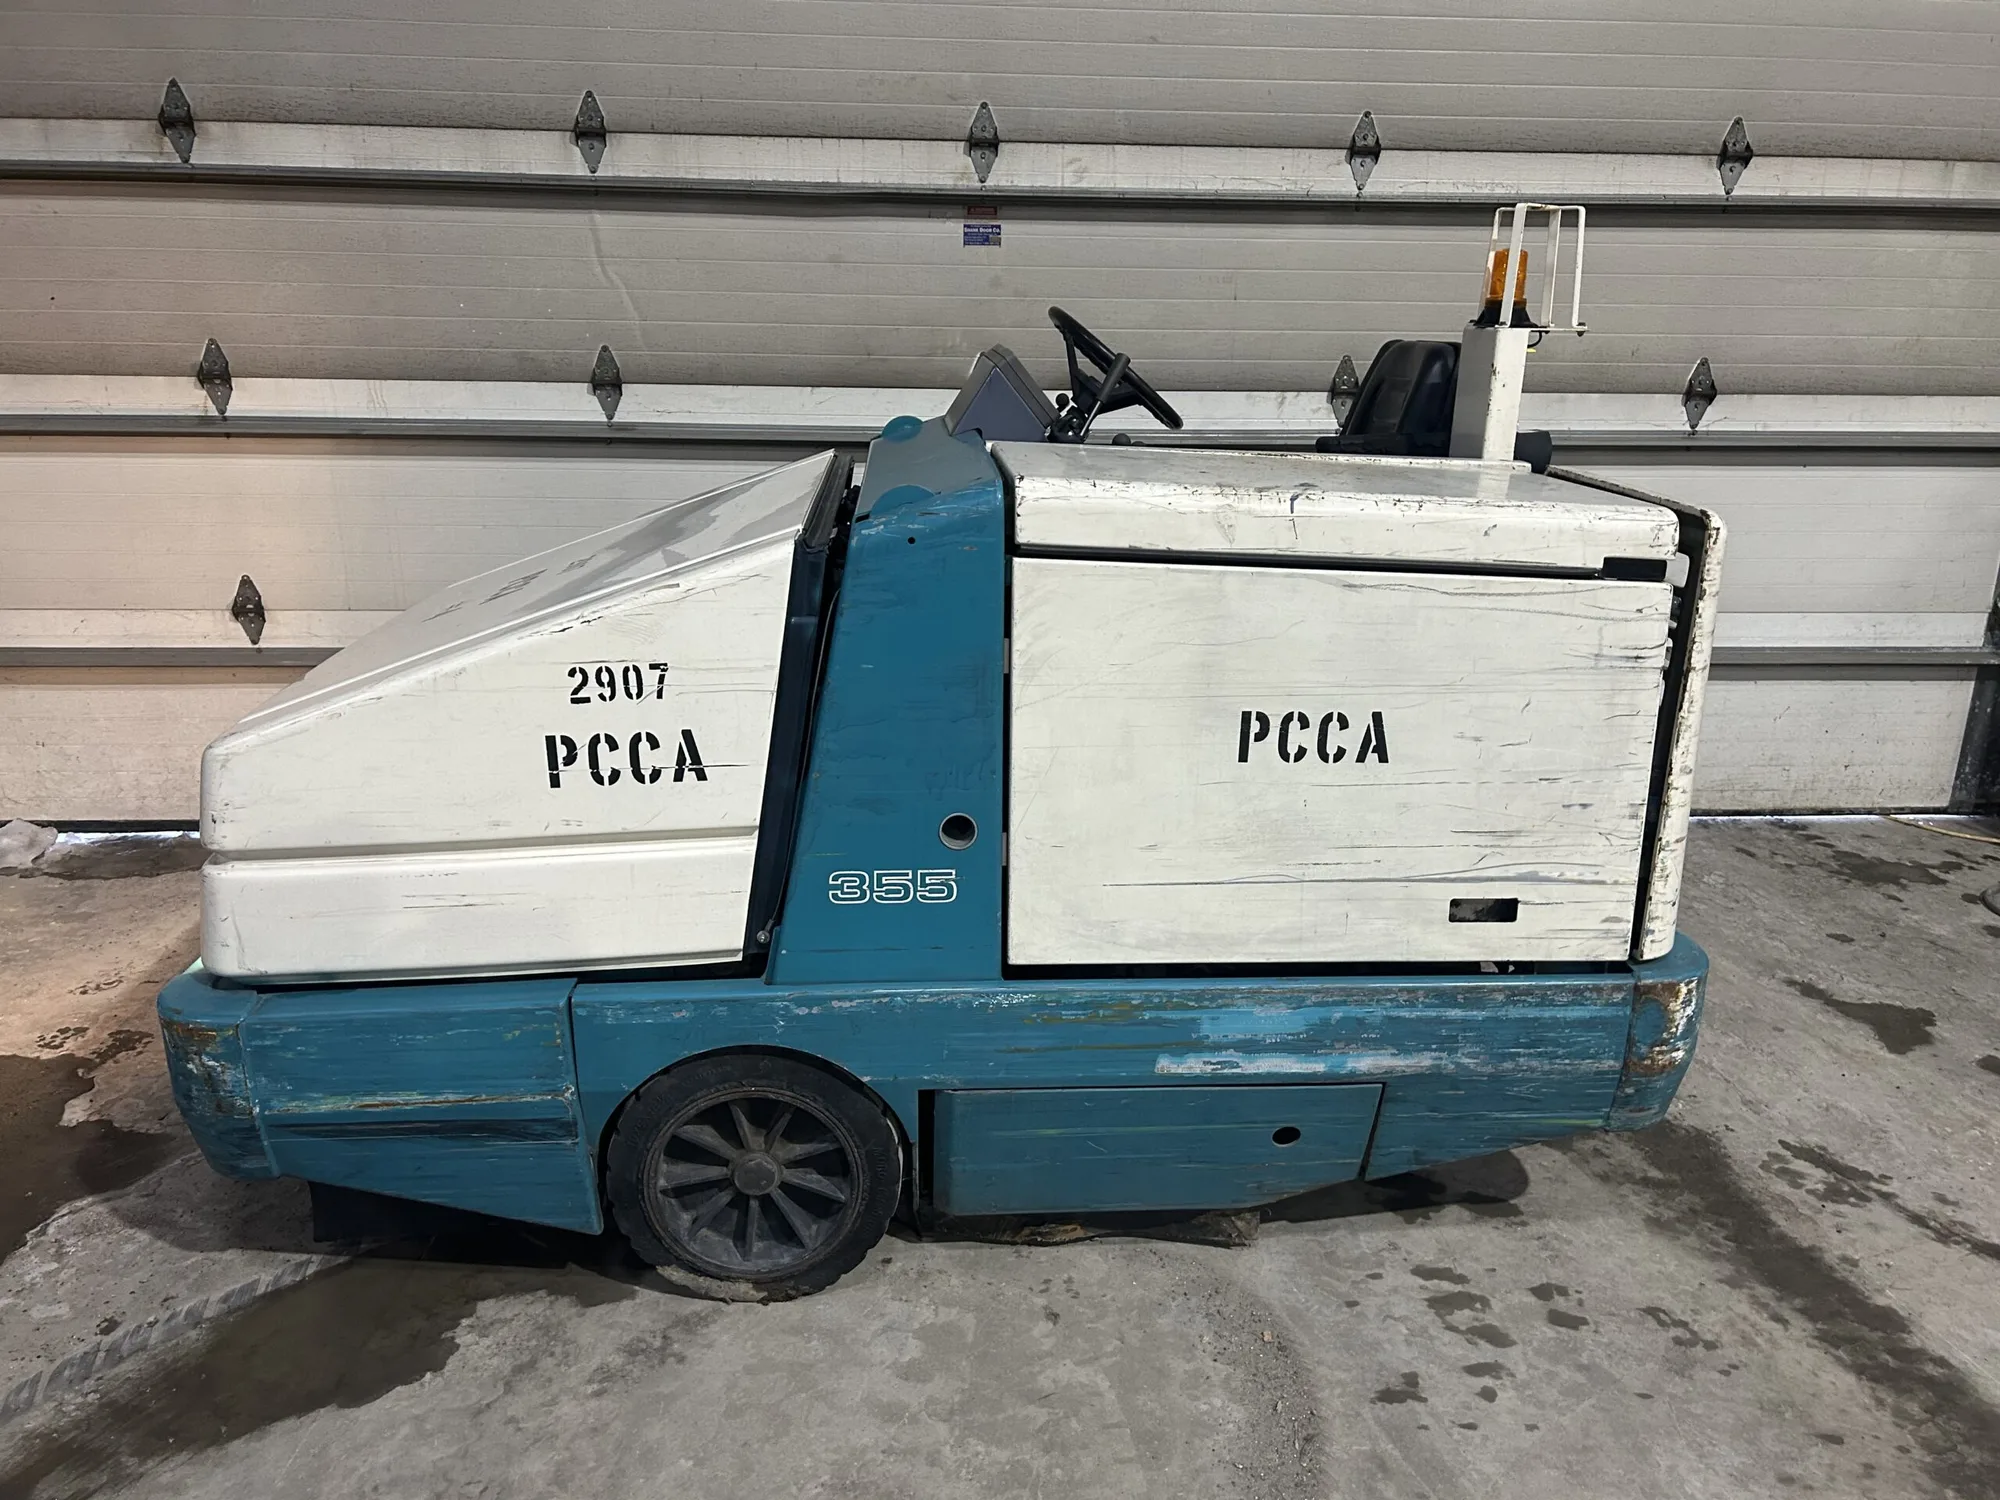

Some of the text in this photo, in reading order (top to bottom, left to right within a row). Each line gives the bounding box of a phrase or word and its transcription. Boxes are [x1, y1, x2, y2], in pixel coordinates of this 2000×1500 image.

[567, 662, 669, 705] 2907
[544, 728, 708, 789] PCCA
[1237, 710, 1389, 765] PCCA
[828, 869, 958, 904] 355
